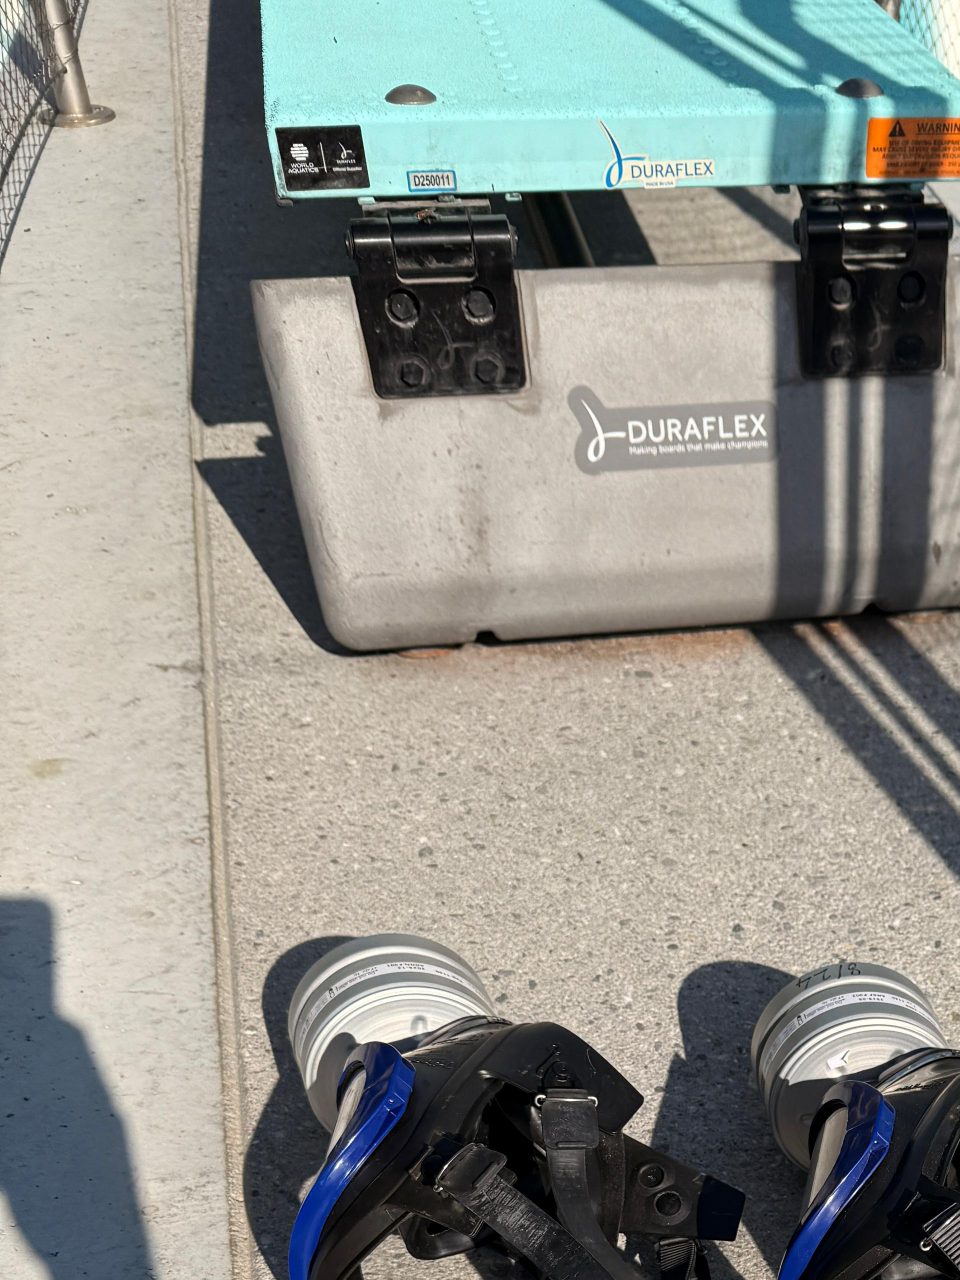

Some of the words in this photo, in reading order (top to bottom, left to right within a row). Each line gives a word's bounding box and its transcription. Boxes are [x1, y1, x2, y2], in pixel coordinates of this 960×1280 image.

[630, 161, 714, 179] DURAFLEX
[413, 174, 452, 188] D250011
[627, 413, 768, 444] DURAFLEX
